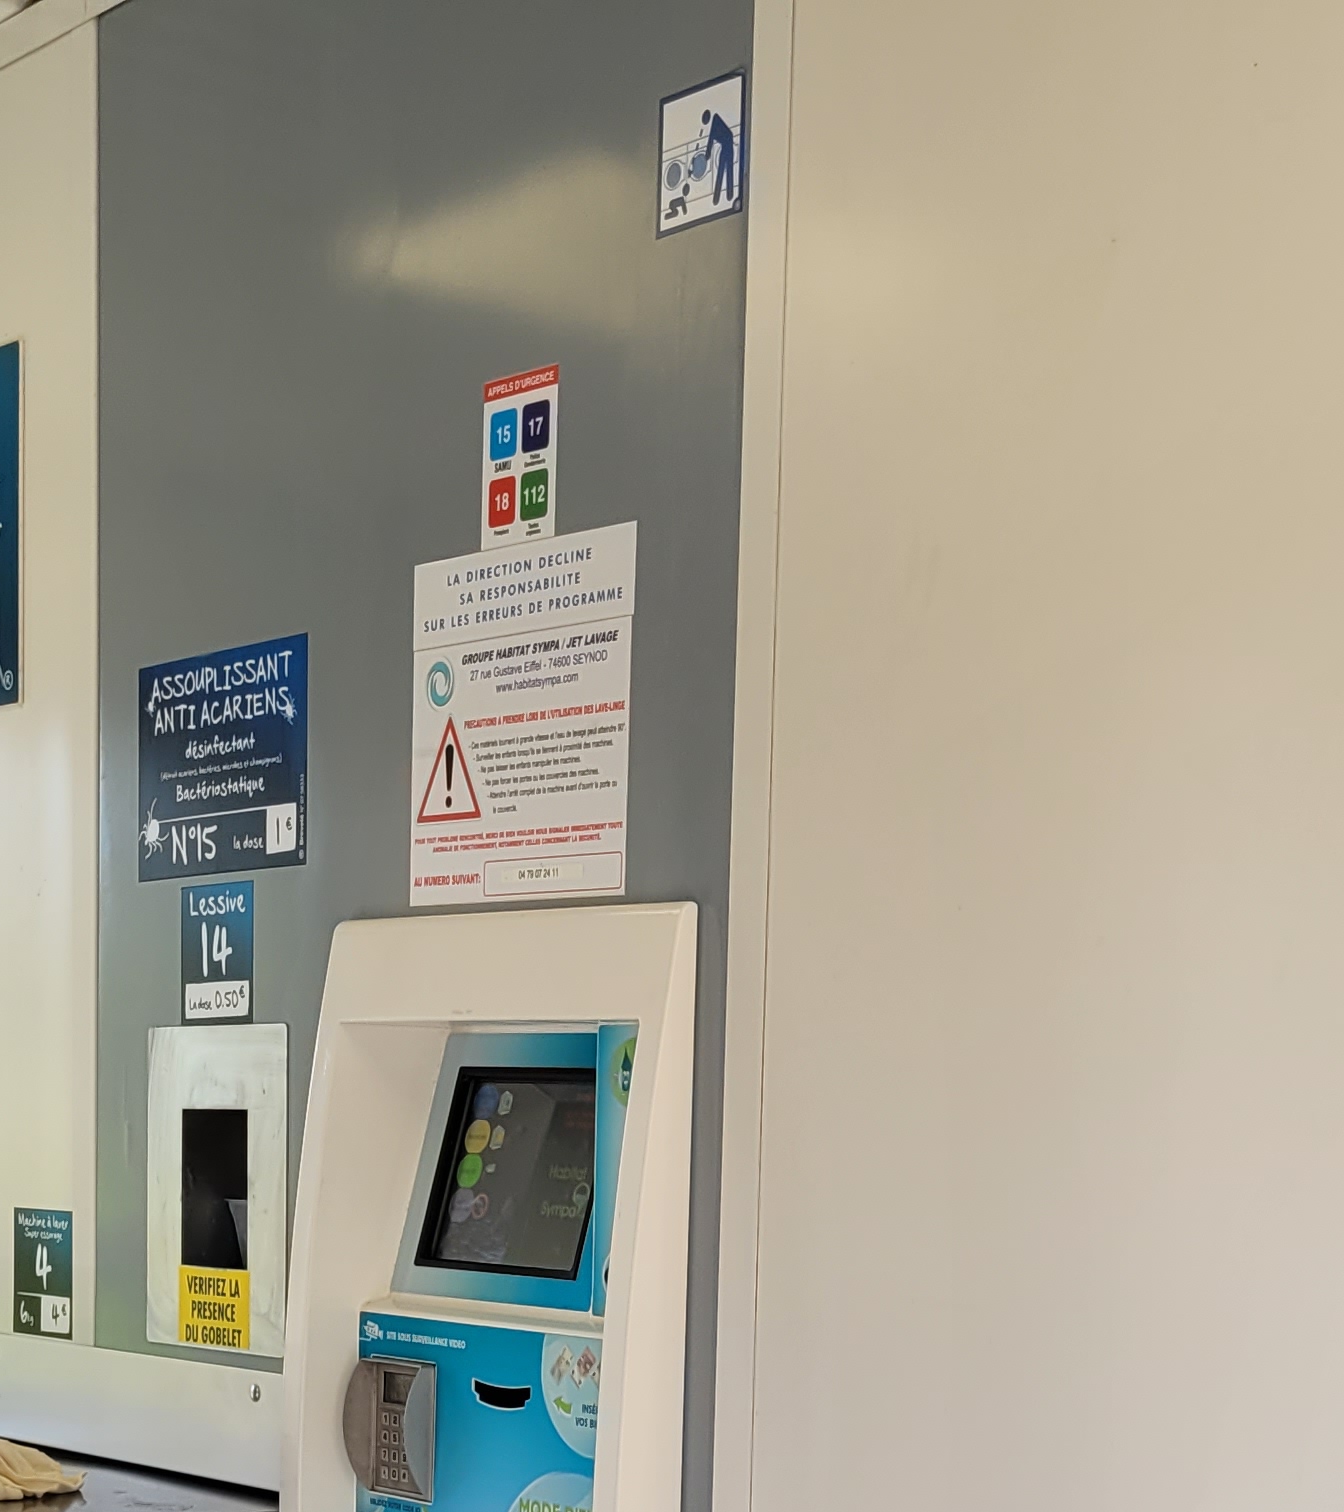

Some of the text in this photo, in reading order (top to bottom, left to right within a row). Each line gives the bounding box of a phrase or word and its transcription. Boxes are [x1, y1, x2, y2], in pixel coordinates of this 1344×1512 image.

[488, 371, 554, 397] APPELS D'URGENCE
[496, 417, 543, 444] 15 17
[494, 460, 512, 473] SAMU
[495, 484, 545, 512] 18 112
[447, 547, 592, 587] LA DIRECTION DECLINE
[460, 572, 581, 606] SA RESPONSABILITE
[423, 587, 623, 633] SUR LES ERREURS DE PROGRAMME
[462, 629, 619, 665] GROUPE HABITAT SYMPA JET LAVAGE
[151, 650, 293, 703] ASSOUPLISSANT
[470, 671, 479, 682] 27
[480, 669, 491, 679] rue
[494, 664, 522, 678] Gustave
[573, 650, 608, 665] SEYNOD
[496, 673, 579, 693] www.habitatsympa.com
[154, 686, 289, 736] ANTI ACARIENS
[185, 732, 256, 760] désinfectant
[176, 776, 265, 802] Bactériostatique
[172, 822, 264, 865] N°15 la dose
[414, 873, 481, 887] AU NUMERO SUIVANT:
[190, 890, 246, 916] Lessive
[202, 922, 232, 977] 14
[18, 1213, 46, 1228] Machine
[36, 1243, 52, 1290] 4
[187, 1275, 240, 1298] VERIFIEZ LA
[191, 1300, 236, 1322] PRESENCE
[185, 1324, 242, 1348] DU GOBELET
[384, 1415, 397, 1424] 1 2
[575, 1417, 588, 1427] VOS
[383, 1432, 397, 1442] 4 5
[383, 1450, 387, 1459] 7
